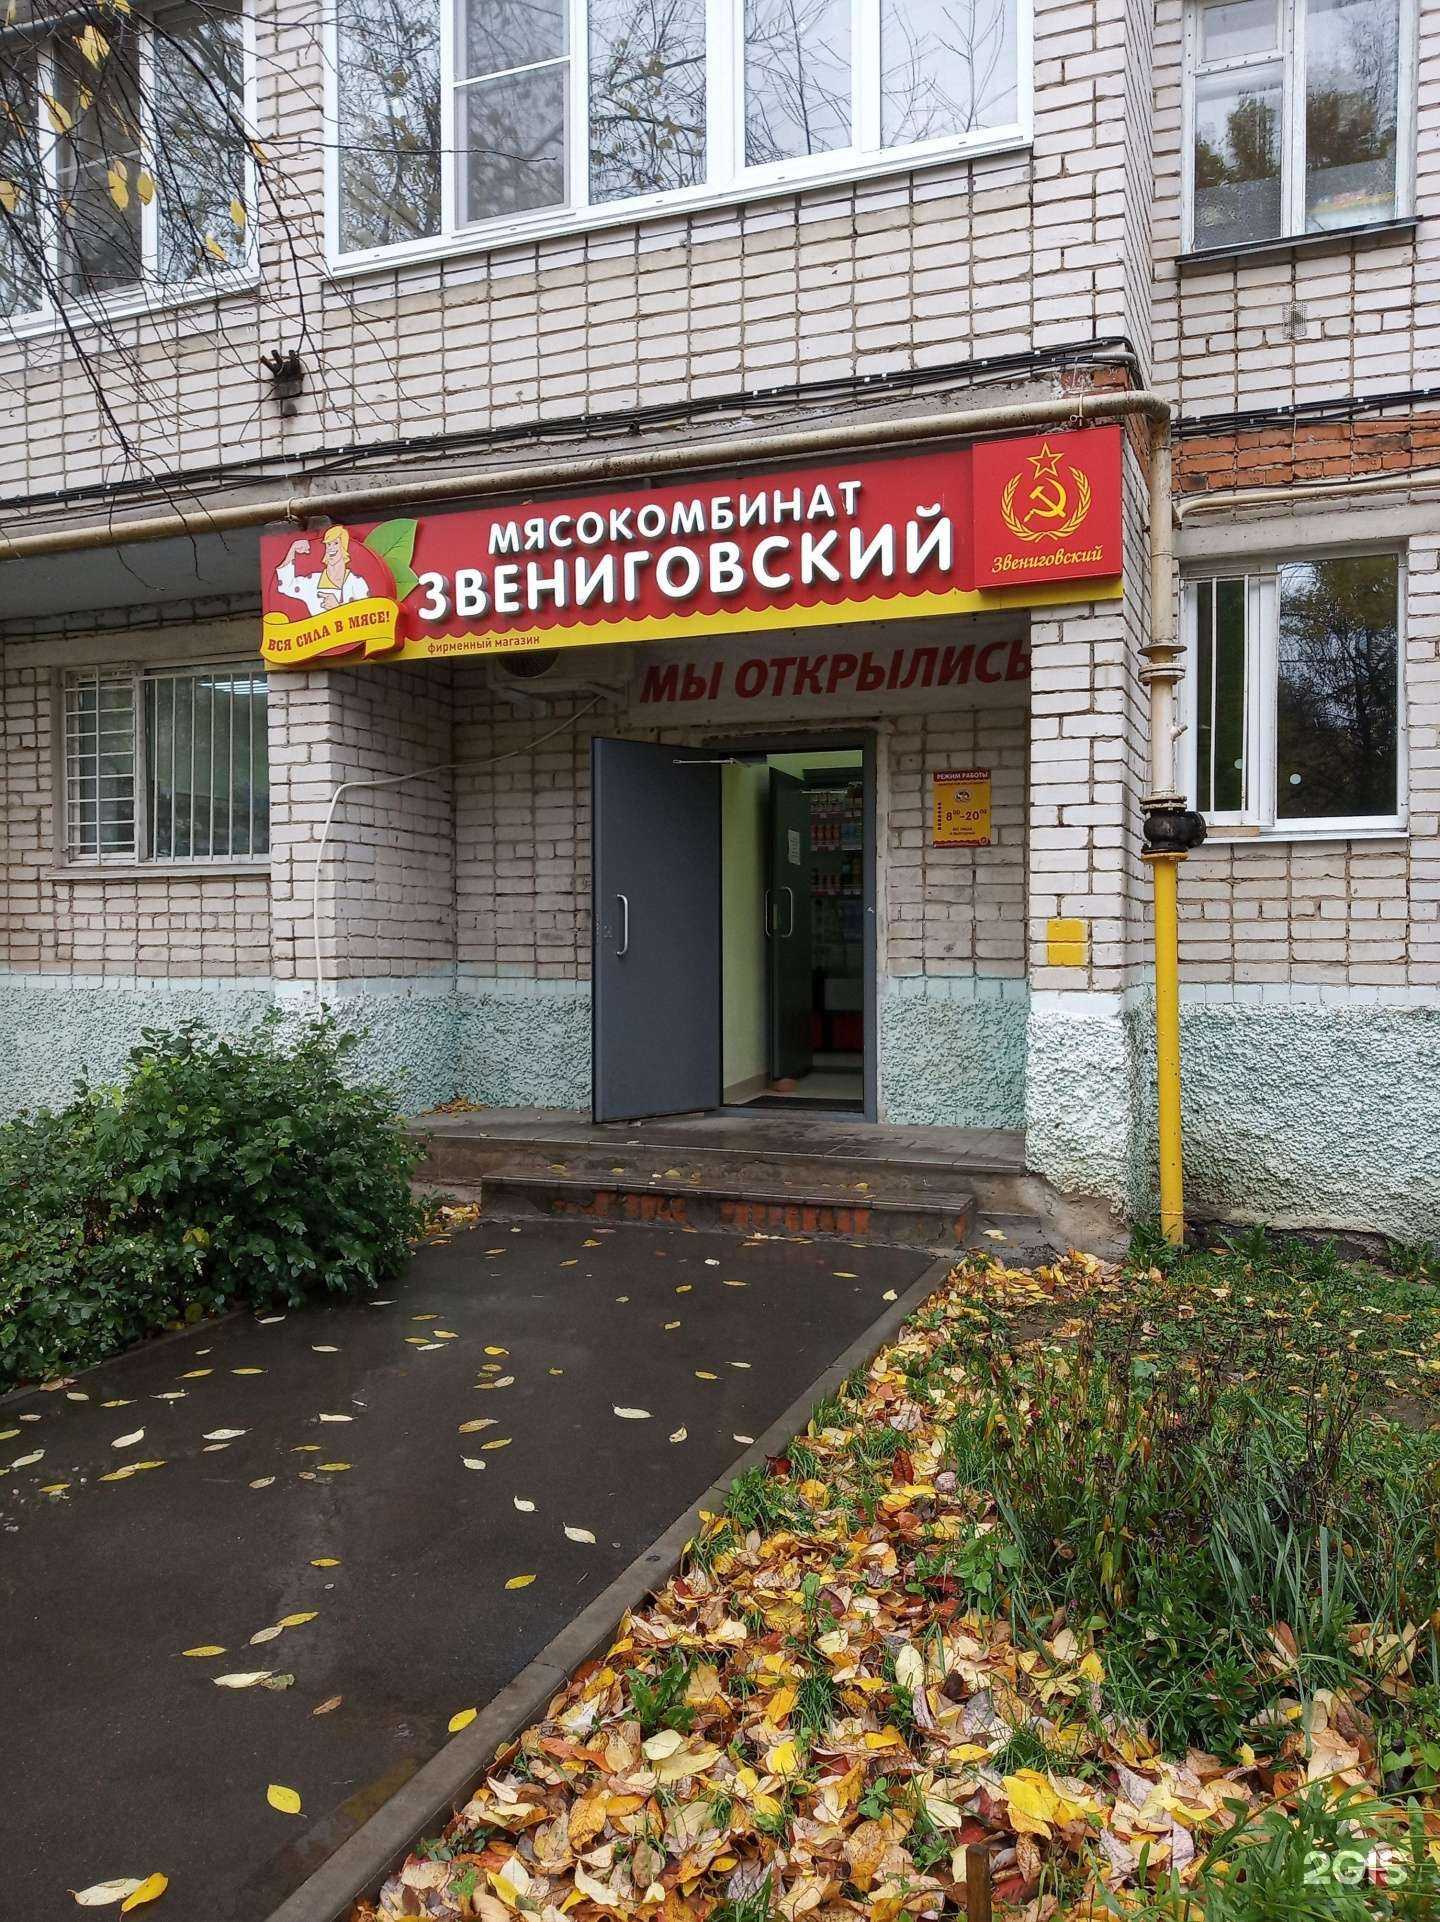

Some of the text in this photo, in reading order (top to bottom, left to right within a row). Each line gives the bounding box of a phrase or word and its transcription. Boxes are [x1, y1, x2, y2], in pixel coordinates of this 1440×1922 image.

[488, 480, 862, 555] МЯСОКОМБИНАТ
[417, 502, 953, 621] ЗВЕНИГОВСКИЙ
[991, 544, 1104, 574] Звениговский
[267, 610, 391, 652] ВСЯ СИЛА В МЯСЕ!
[427, 634, 541, 655] фирменный магазин
[640, 639, 1031, 704] МЫ ОТКРЫЛИСЬ
[936, 771, 988, 780] РЕЖИМ РАБОТЫ
